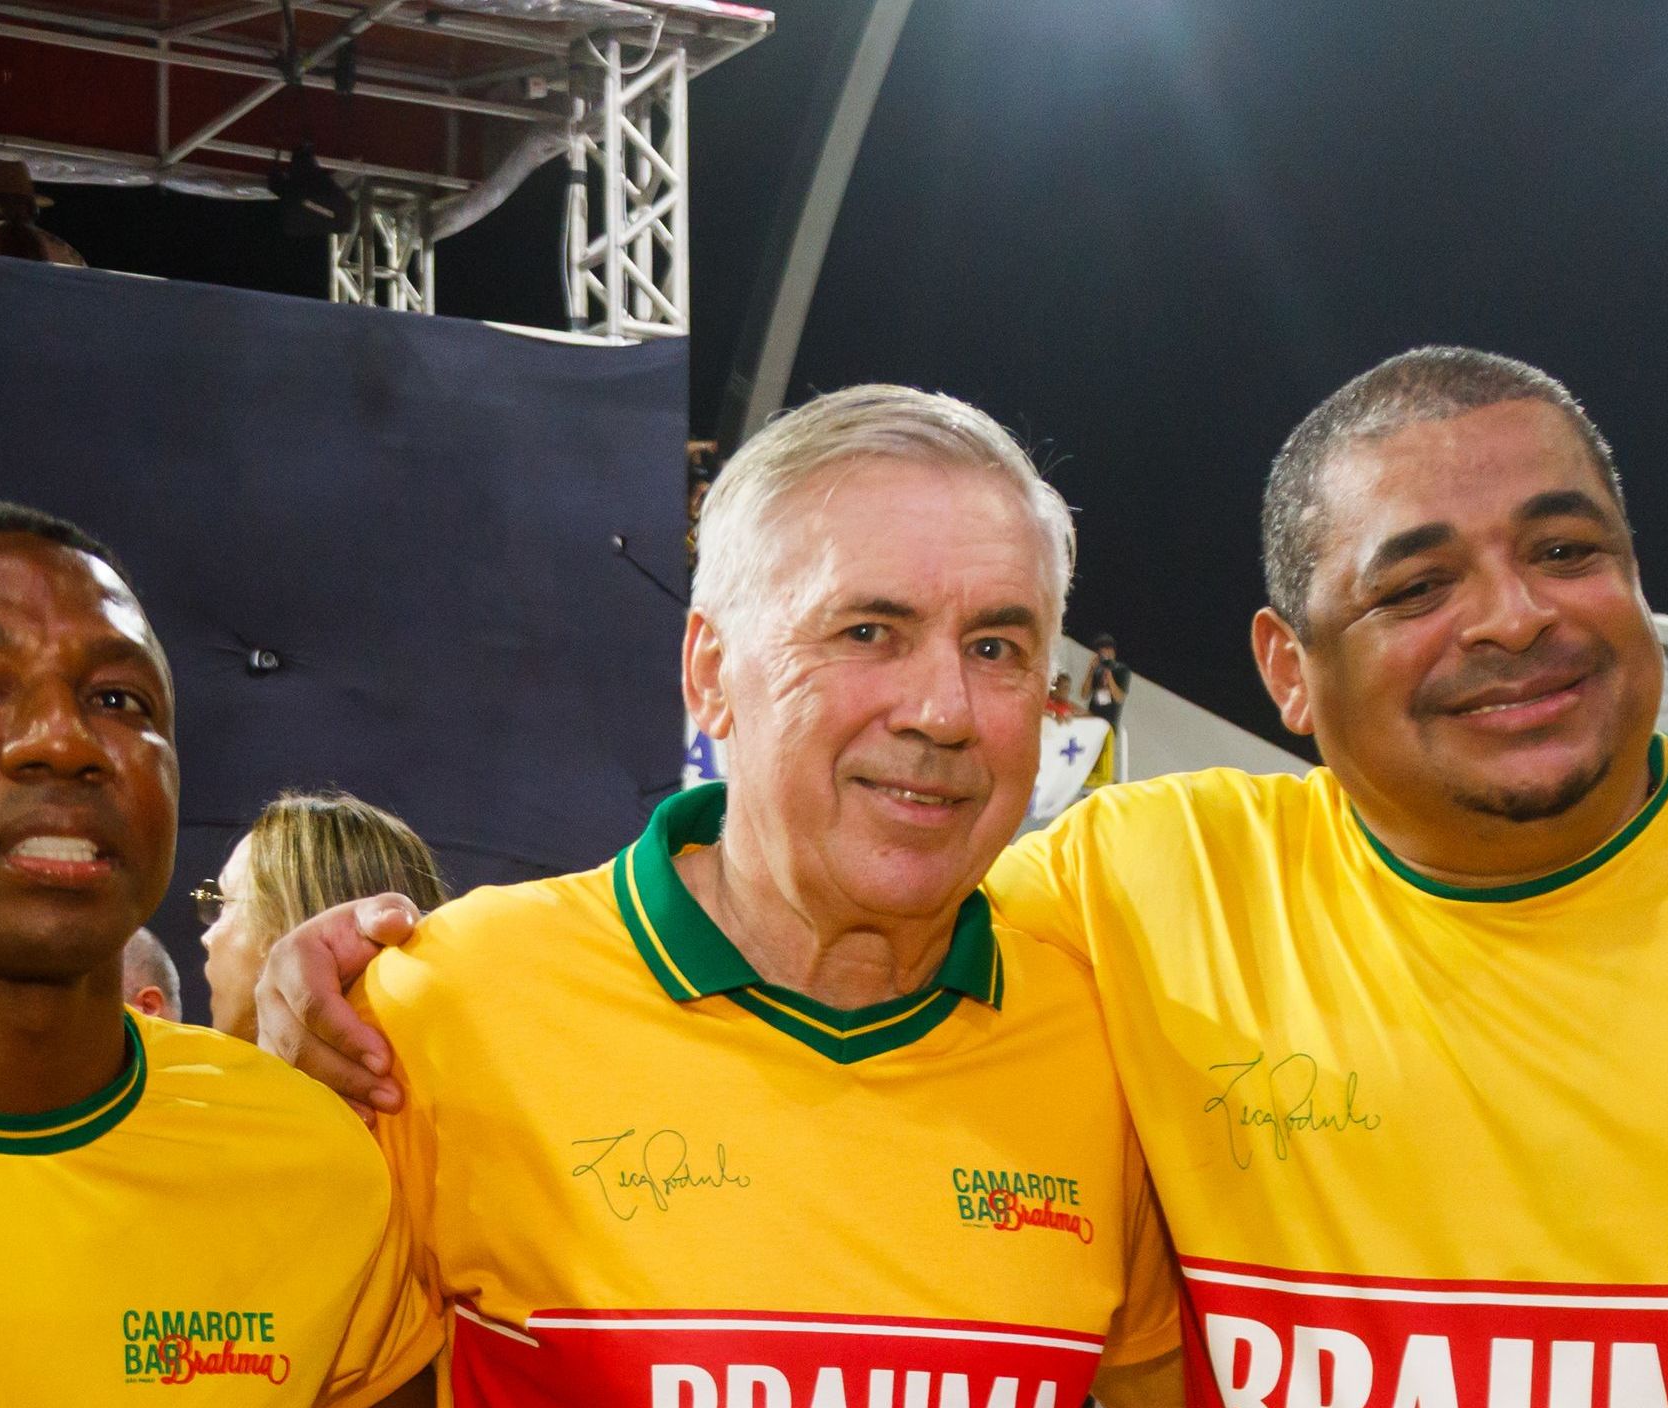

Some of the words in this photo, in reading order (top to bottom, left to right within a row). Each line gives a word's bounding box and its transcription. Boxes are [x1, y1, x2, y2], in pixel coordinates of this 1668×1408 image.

[952, 1168, 1081, 1206] CAMAROTE
[957, 1194, 1011, 1224] BAR
[988, 1188, 1094, 1244] Brahma
[123, 1310, 275, 1342] CAMAROTE
[125, 1343, 182, 1375] BAR
[159, 1333, 291, 1385] Brahma
